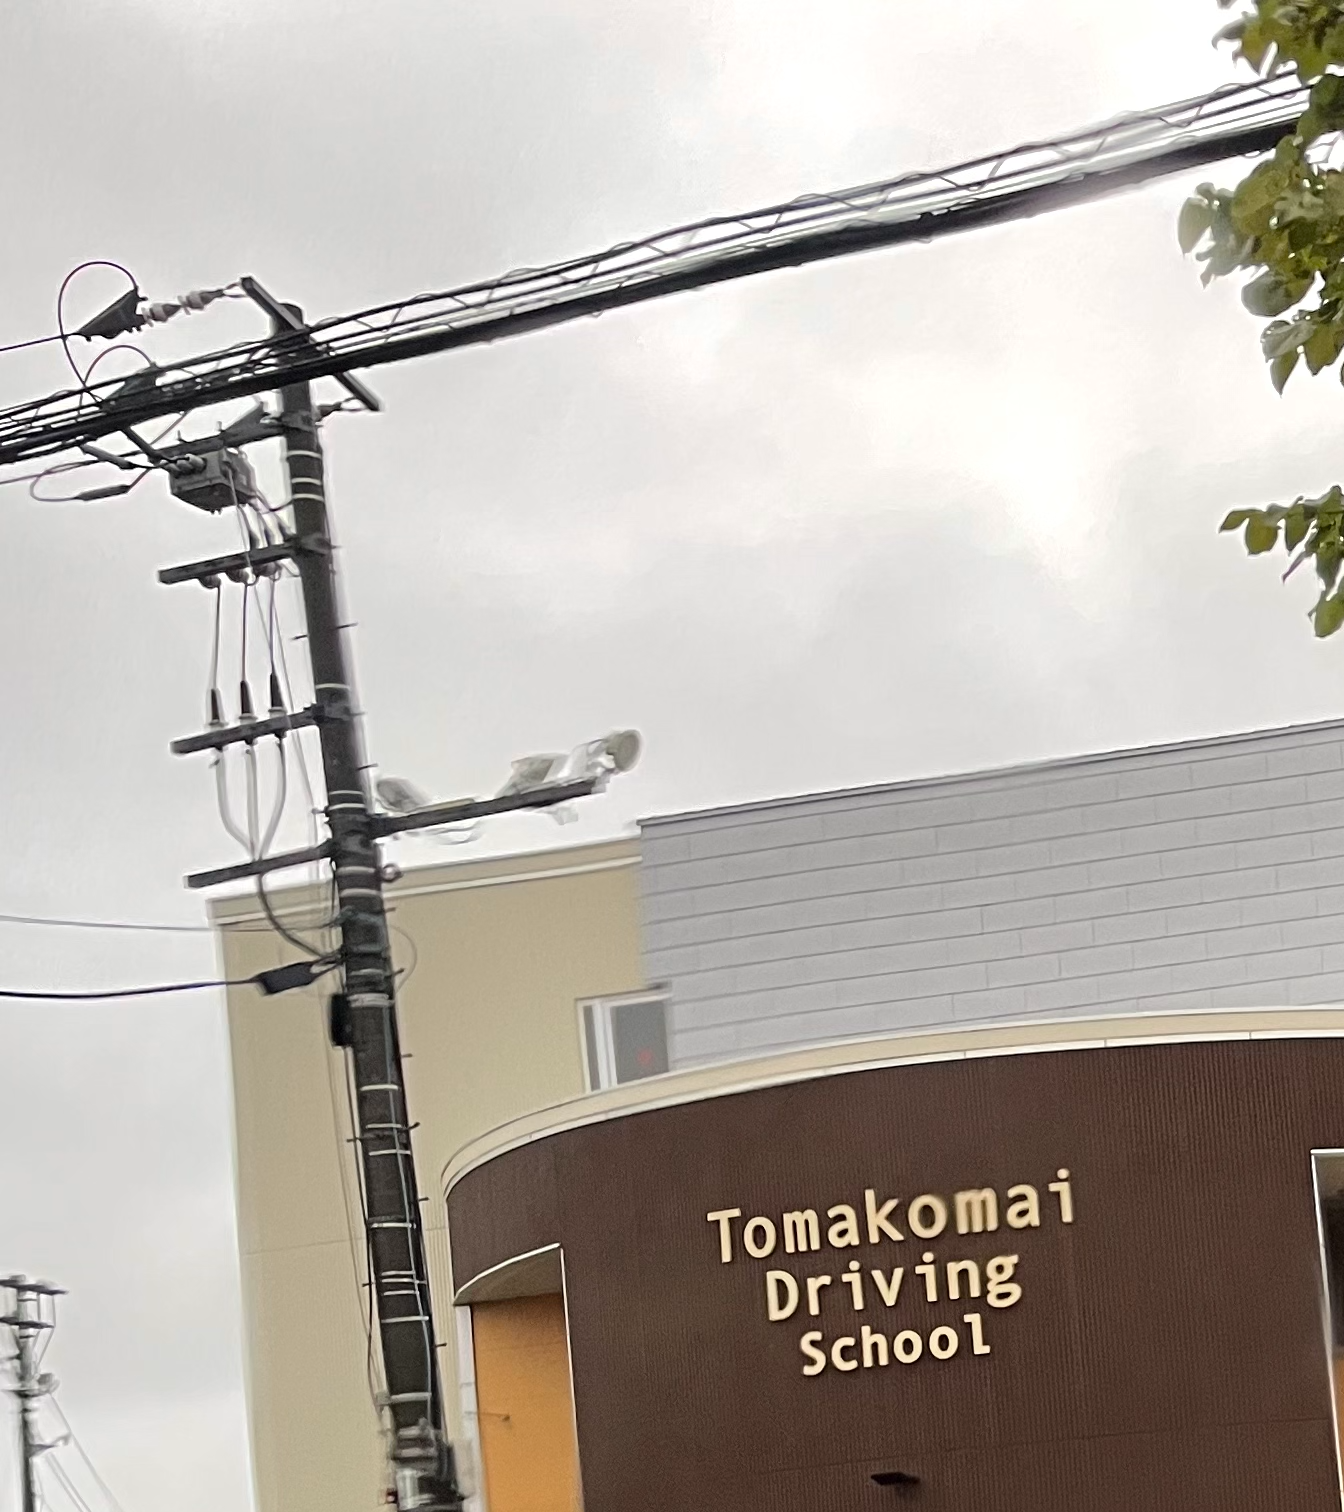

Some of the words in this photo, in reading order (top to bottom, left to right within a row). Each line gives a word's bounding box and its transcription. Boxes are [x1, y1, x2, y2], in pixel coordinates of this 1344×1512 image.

[706, 1168, 1074, 1264] Tomakomai
[766, 1252, 1022, 1322] Driving
[800, 1313, 991, 1377] School
